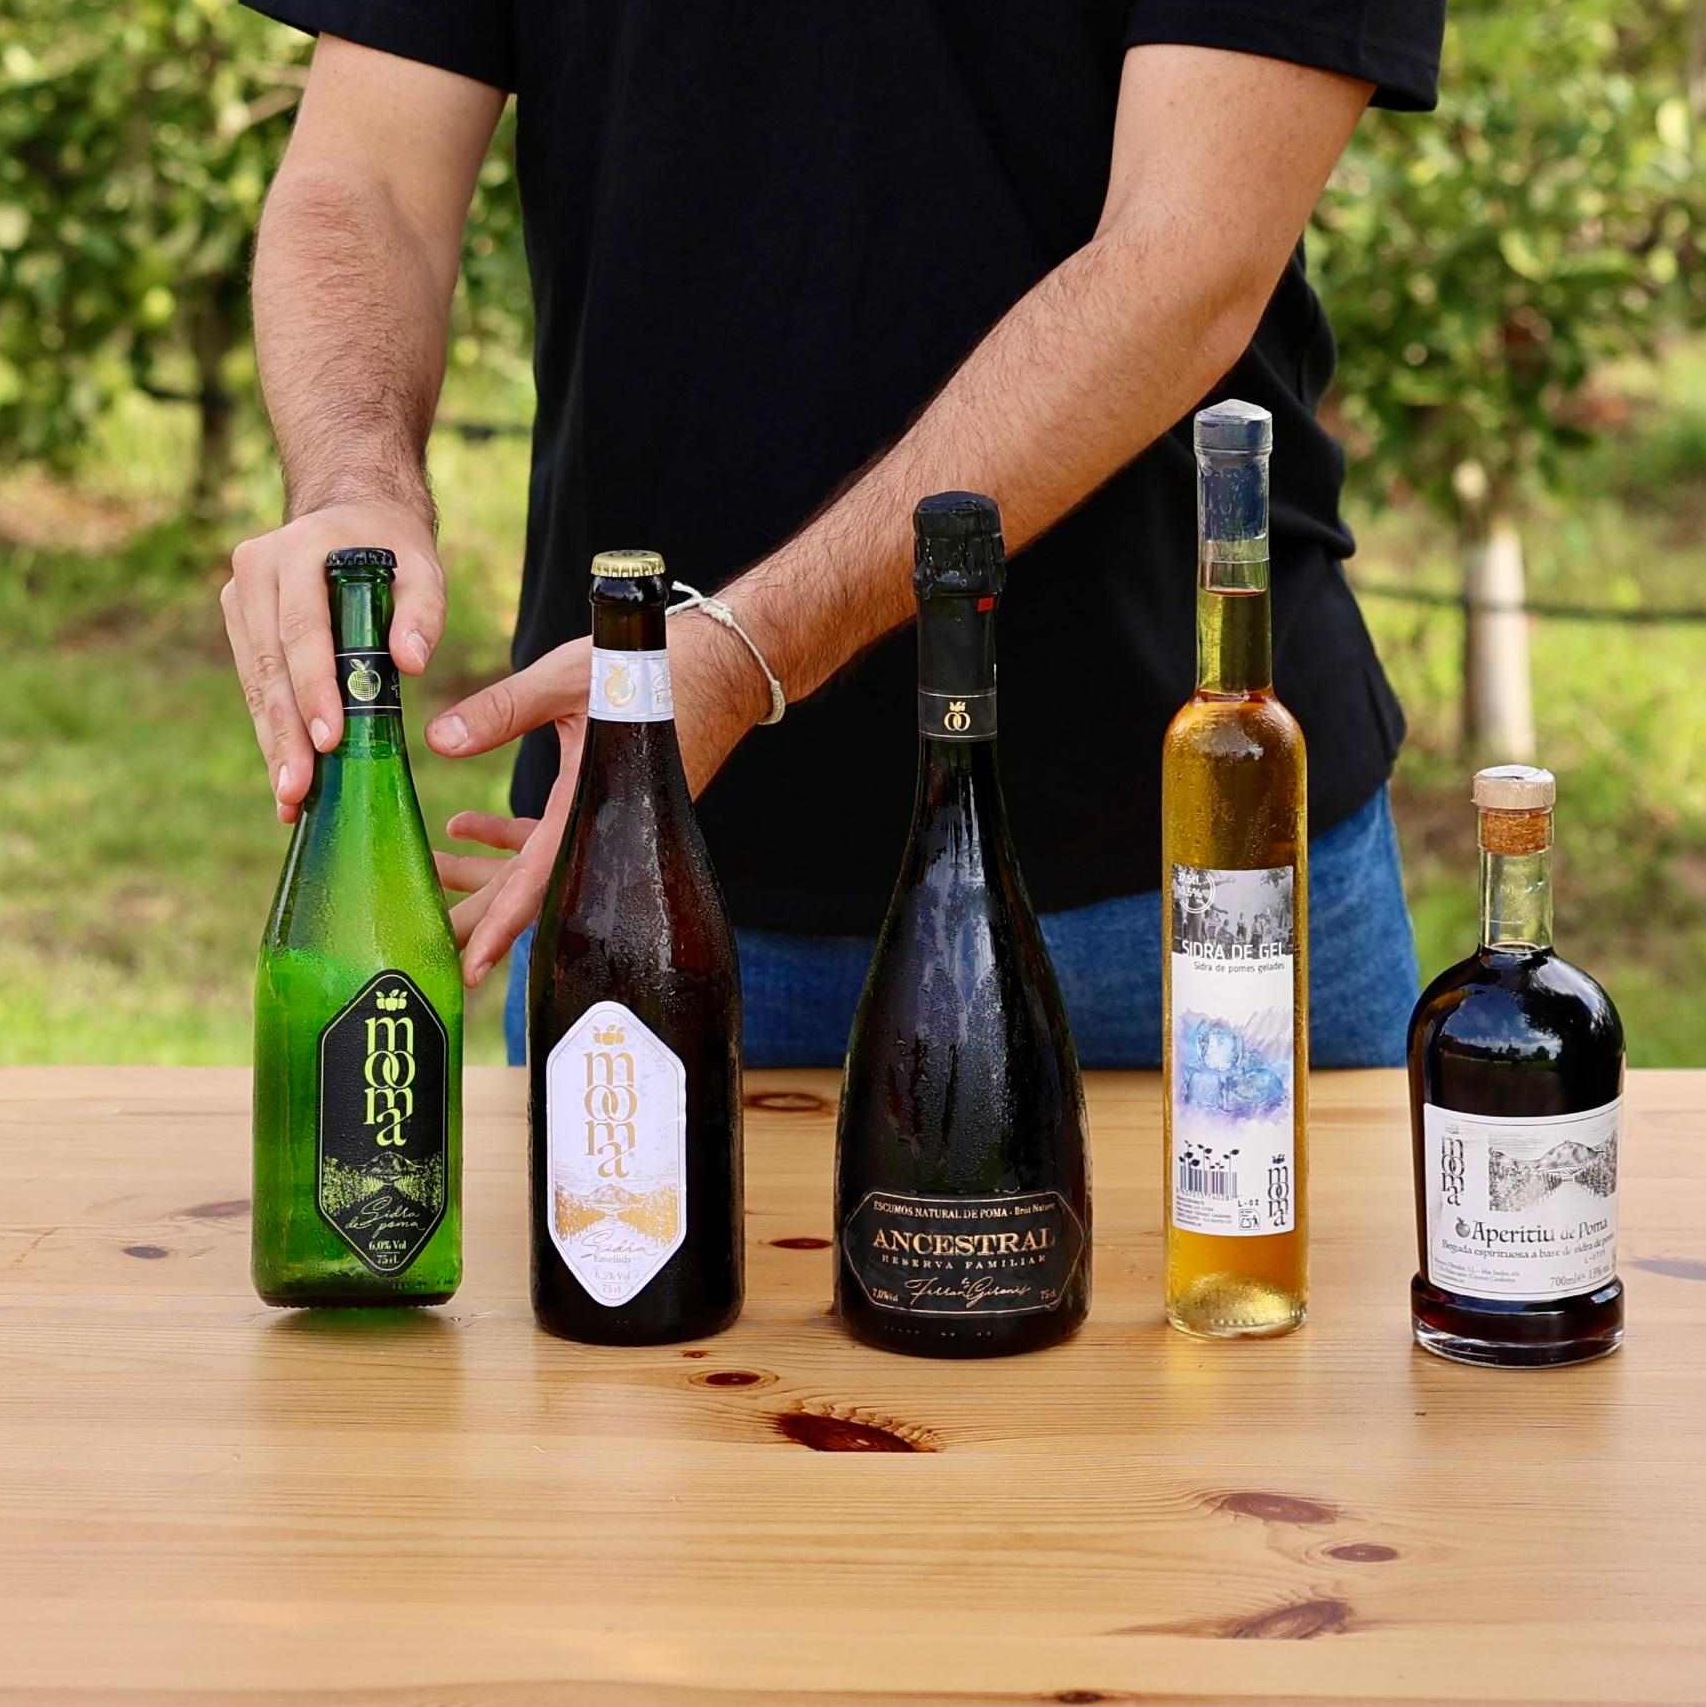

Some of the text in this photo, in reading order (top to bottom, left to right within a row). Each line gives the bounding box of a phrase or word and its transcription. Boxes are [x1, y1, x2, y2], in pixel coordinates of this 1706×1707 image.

[1182, 940, 1284, 960] SIDRA DE GEL
[1193, 961, 1285, 974] Sidra de pomes gelades
[915, 1207, 962, 1219] NATURAL
[963, 1209, 979, 1219] DE
[980, 1207, 1008, 1218] POMA
[1472, 1217, 1608, 1247] Aperitiu de Poma
[872, 1227, 1056, 1256] ANCESTRAL
[882, 1254, 1046, 1270] RESERVA FAMILIAR
